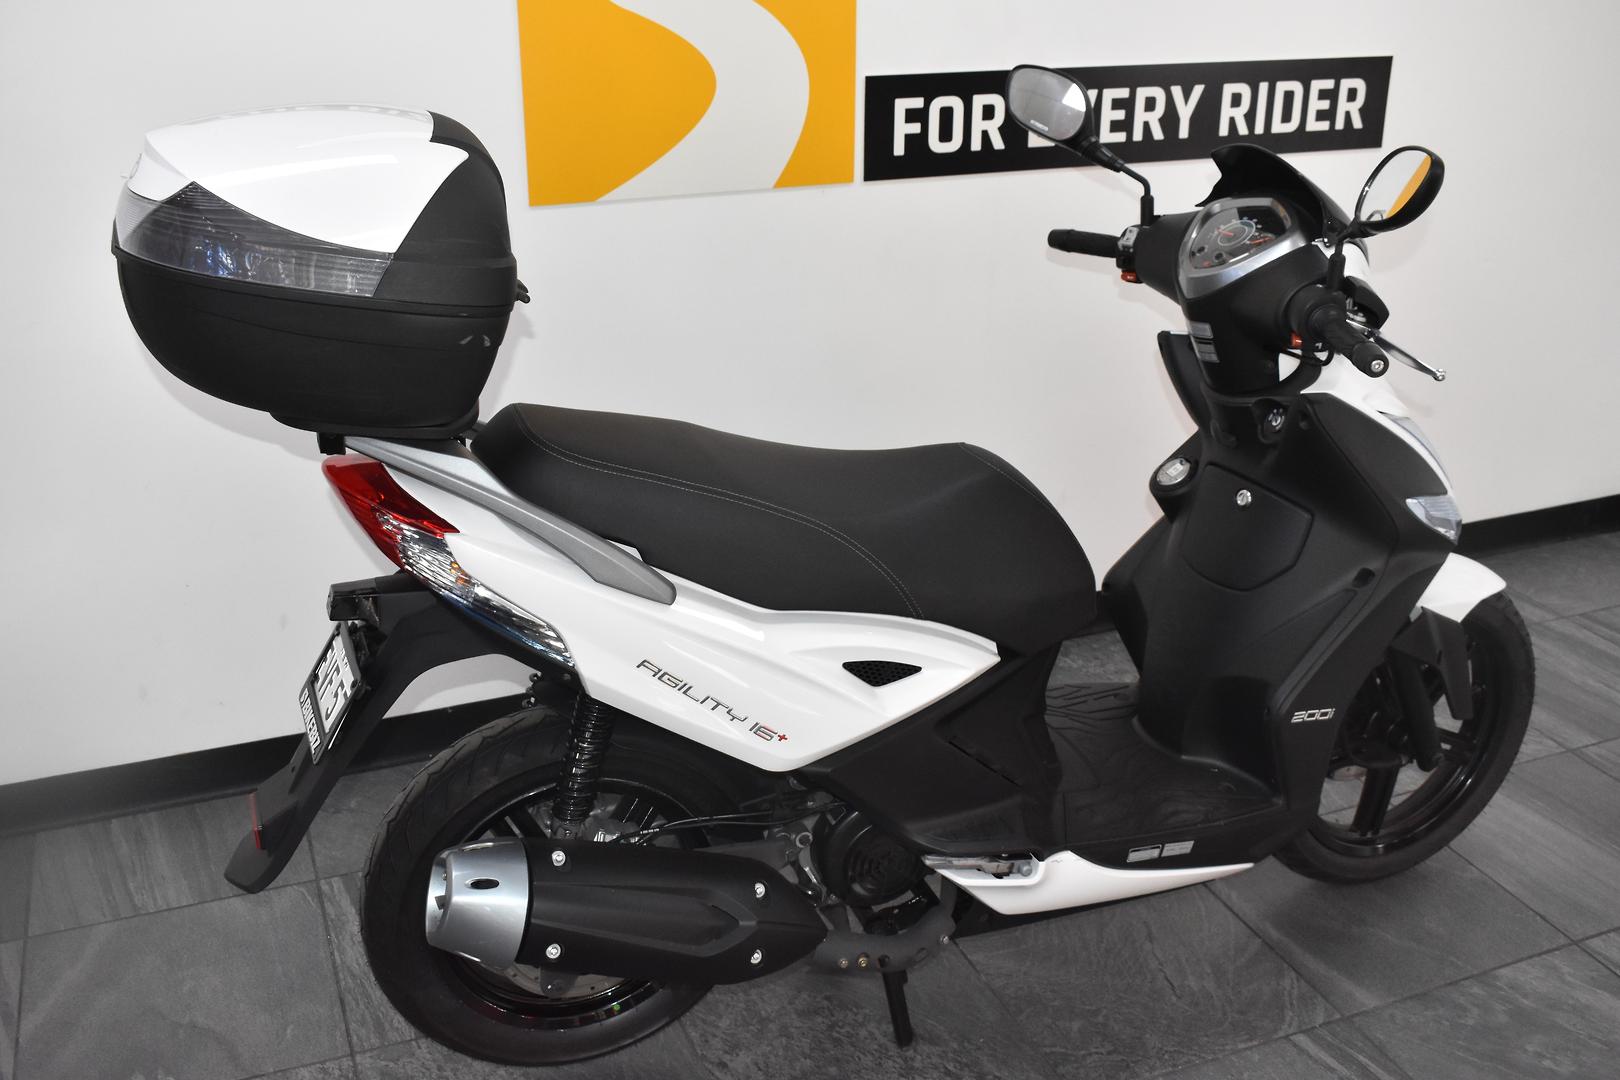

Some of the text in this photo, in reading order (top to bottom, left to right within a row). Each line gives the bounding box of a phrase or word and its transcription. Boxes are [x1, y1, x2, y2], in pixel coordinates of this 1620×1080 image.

[893, 77, 1368, 156] FOR ERY RIDER
[636, 659, 749, 722] AGILITY
[1291, 708, 1336, 723] 200i
[302, 697, 322, 754] BIKEBIZ
